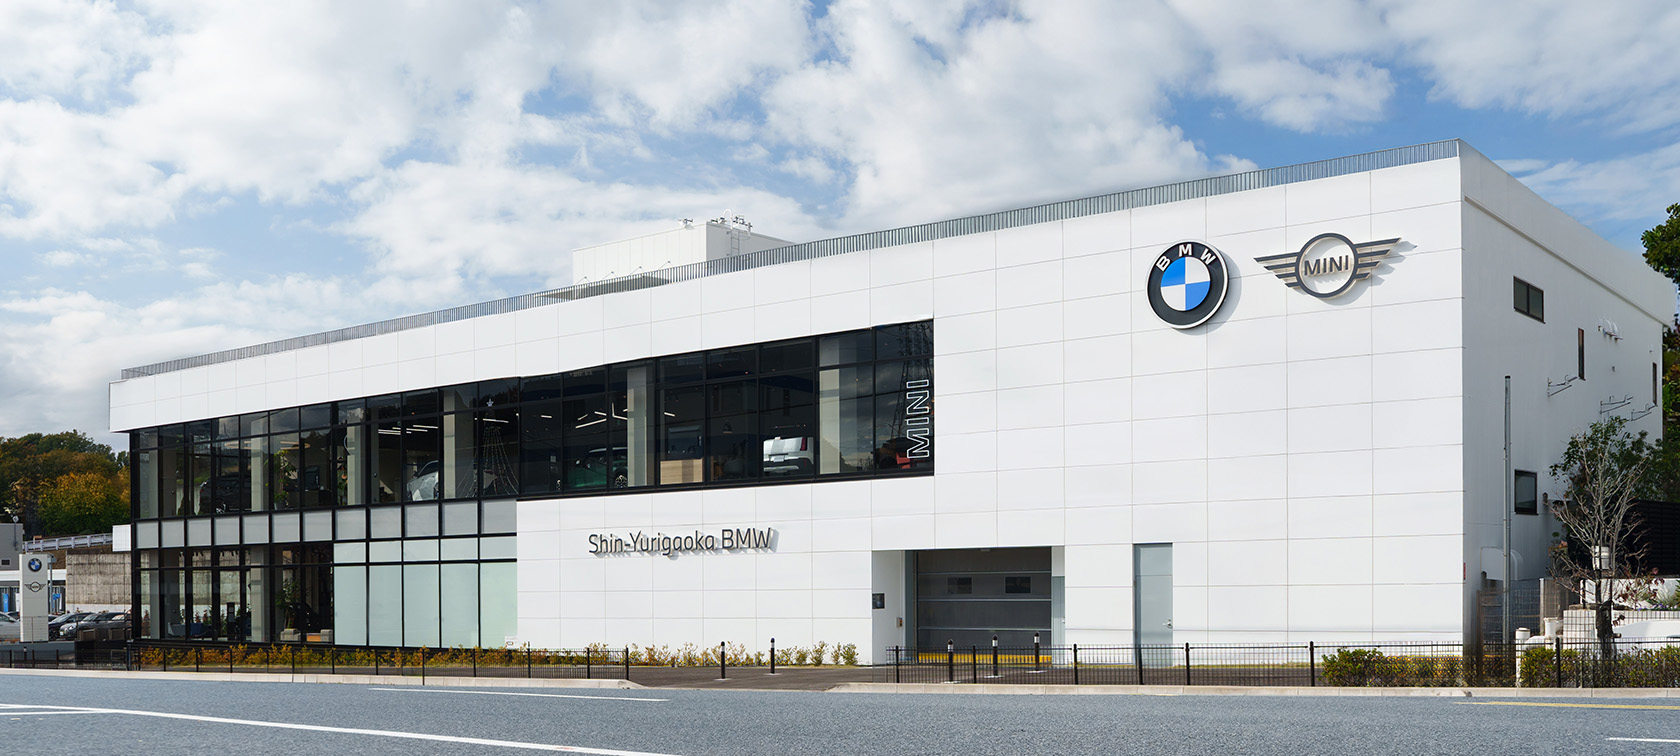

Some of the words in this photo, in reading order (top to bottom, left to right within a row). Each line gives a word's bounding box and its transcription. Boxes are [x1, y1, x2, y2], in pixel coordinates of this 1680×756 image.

[1155, 243, 1217, 272] BMW
[1304, 254, 1350, 276] MINI
[906, 379, 930, 459] MINI
[588, 530, 715, 556] Shin-Yurigaoka
[721, 527, 771, 549] BMW
